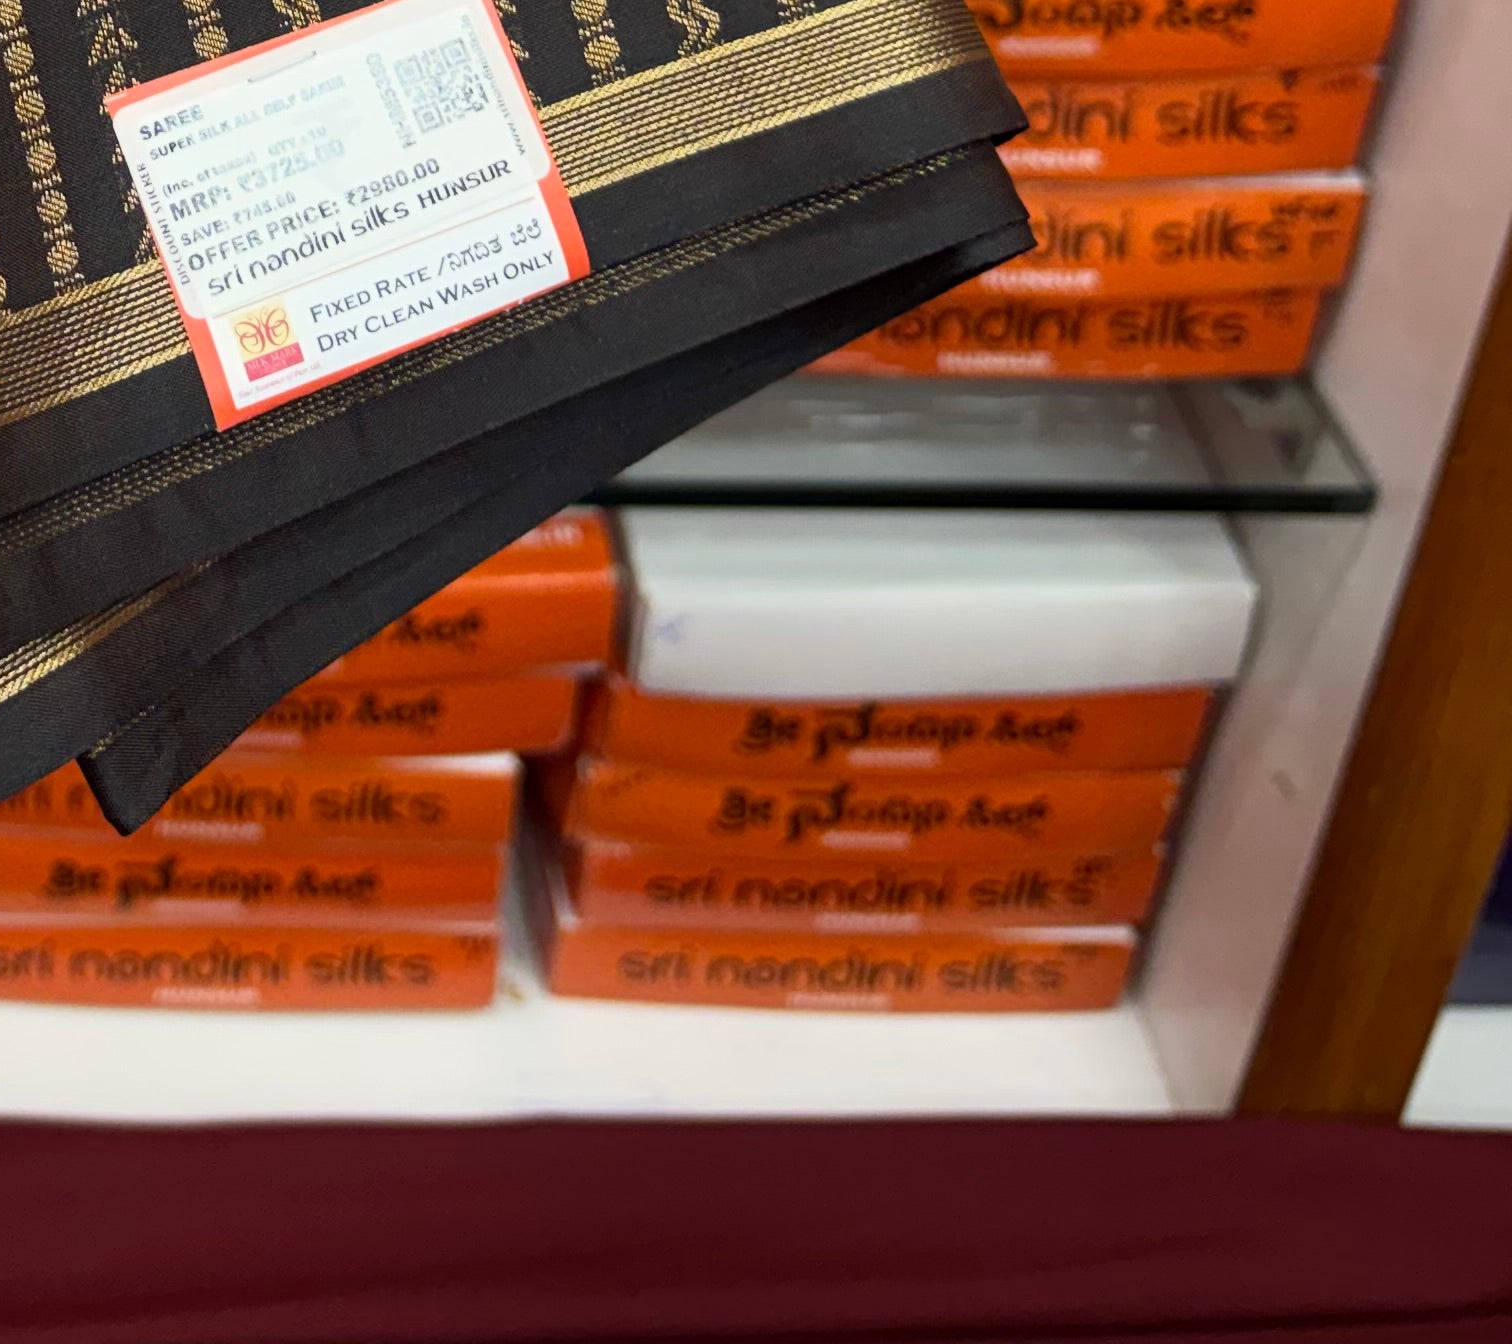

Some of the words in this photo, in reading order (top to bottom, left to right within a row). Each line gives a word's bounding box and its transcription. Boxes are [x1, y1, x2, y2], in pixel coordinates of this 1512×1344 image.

[169, 187, 231, 221] MRP:
[188, 230, 263, 271] OFFER
[266, 201, 339, 240] PRICE:
[209, 265, 243, 295] sri
[249, 222, 346, 279] nandini
[352, 202, 409, 236] silks
[417, 160, 511, 208] HUNSUR
[310, 291, 370, 323] FIXED
[375, 267, 431, 298] RATE
[317, 326, 357, 352] DRY
[365, 297, 434, 333] CLEAN
[437, 273, 499, 304] WASH
[504, 251, 552, 279] ONLY
